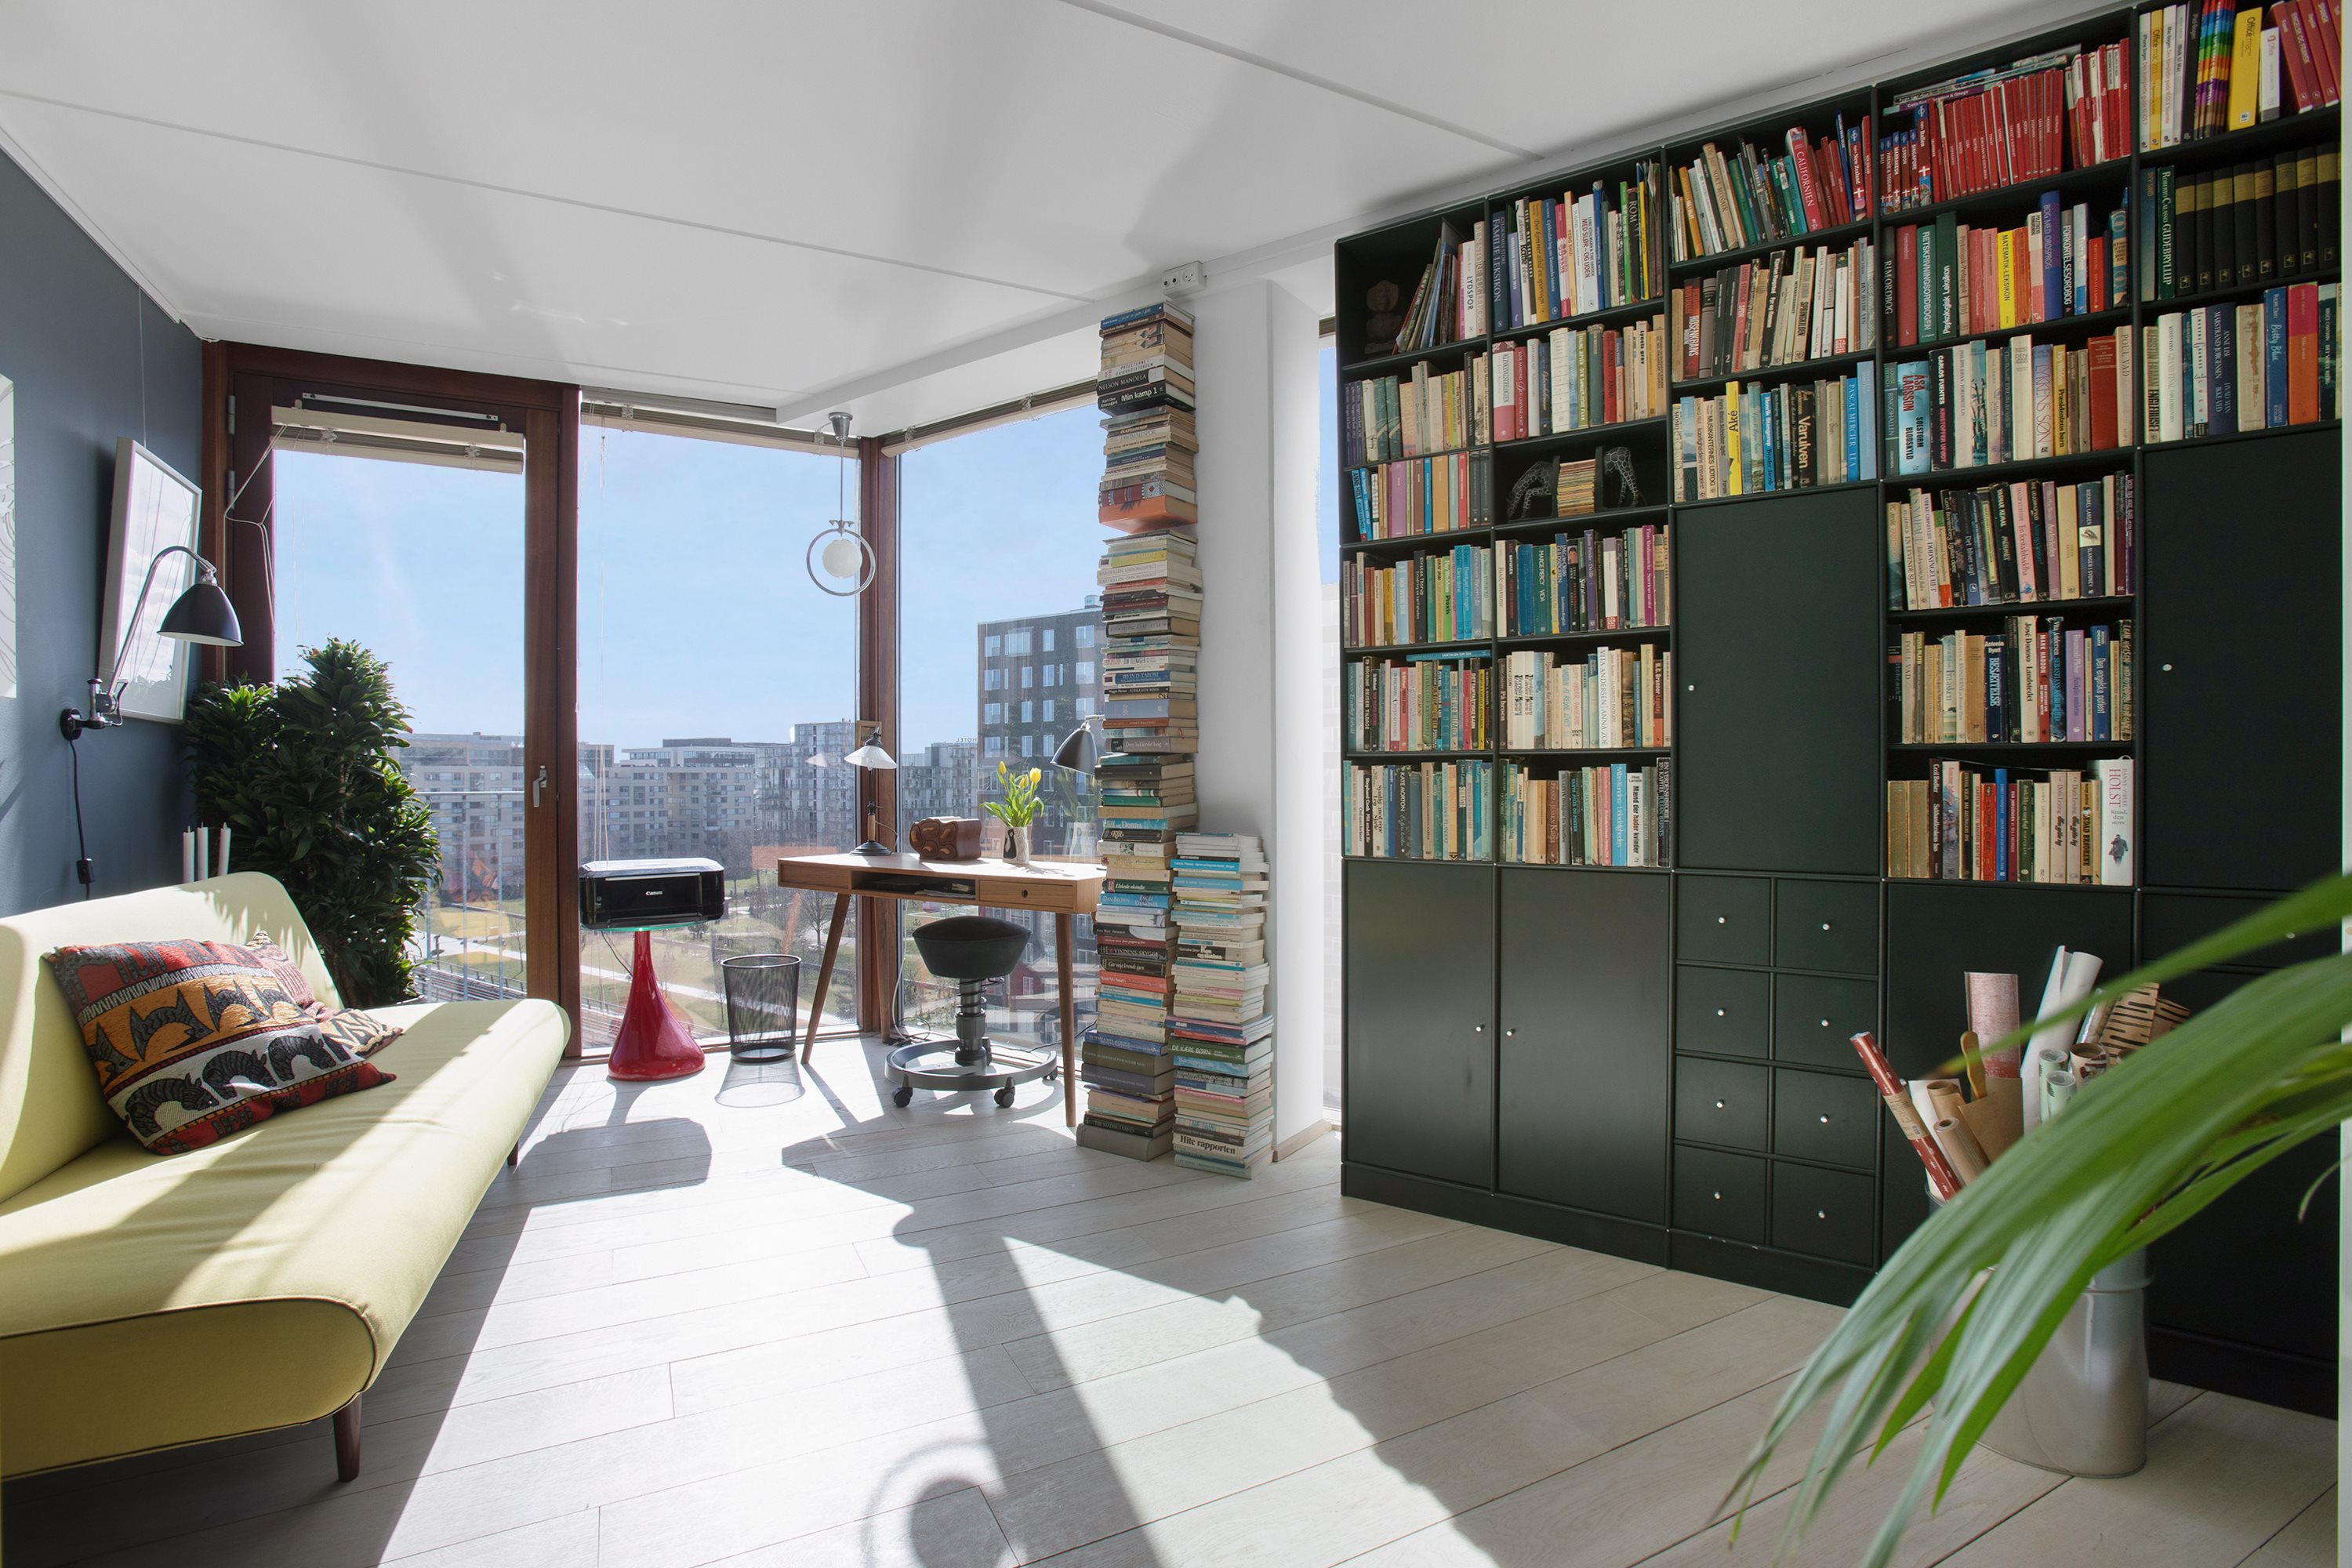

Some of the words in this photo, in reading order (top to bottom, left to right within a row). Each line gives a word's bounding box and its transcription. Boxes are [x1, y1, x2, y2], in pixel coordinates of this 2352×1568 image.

[2246, 17, 2256, 37] Office
[1796, 151, 1814, 207] CALIFORNIEN
[2043, 204, 2052, 218] BOG
[1584, 252, 1589, 261] OG
[2044, 235, 2053, 269] ORDSPROG
[2063, 225, 2072, 305] FORKORTELSESORDBOG
[2162, 224, 2172, 285] GUDEBRYLLUP
[1922, 231, 1932, 330] RETSKRIVNINGSORDBOGEN
[1943, 296, 1951, 334] Psykologisk
[1688, 315, 1699, 356] ROSENKRANS
[2147, 329, 2158, 361] KERSTIN
[1098, 381, 1119, 391] NELSON
[1120, 375, 1146, 386] MANDELA
[1915, 375, 1928, 391] ÅSA
[2035, 363, 2050, 412] LYKKENS
[2148, 362, 2158, 387] EKMAN
[1134, 390, 1152, 399] kamp
[1903, 376, 1915, 412] LARSSON
[2148, 390, 2158, 432] ENGLEHUSET
[1798, 416, 1811, 469] Varulven
[2036, 415, 2051, 443] SØN
[2096, 658, 2106, 669] Den
[1501, 691, 1506, 700] På
[1989, 658, 2000, 706] BESÆTTELSE
[2094, 670, 2104, 694] engelske
[2095, 695, 2106, 713] patient
[2109, 768, 2121, 808] HOLST
[1180, 1134, 1195, 1146] Hite
[1197, 1139, 1236, 1154] rapporten
